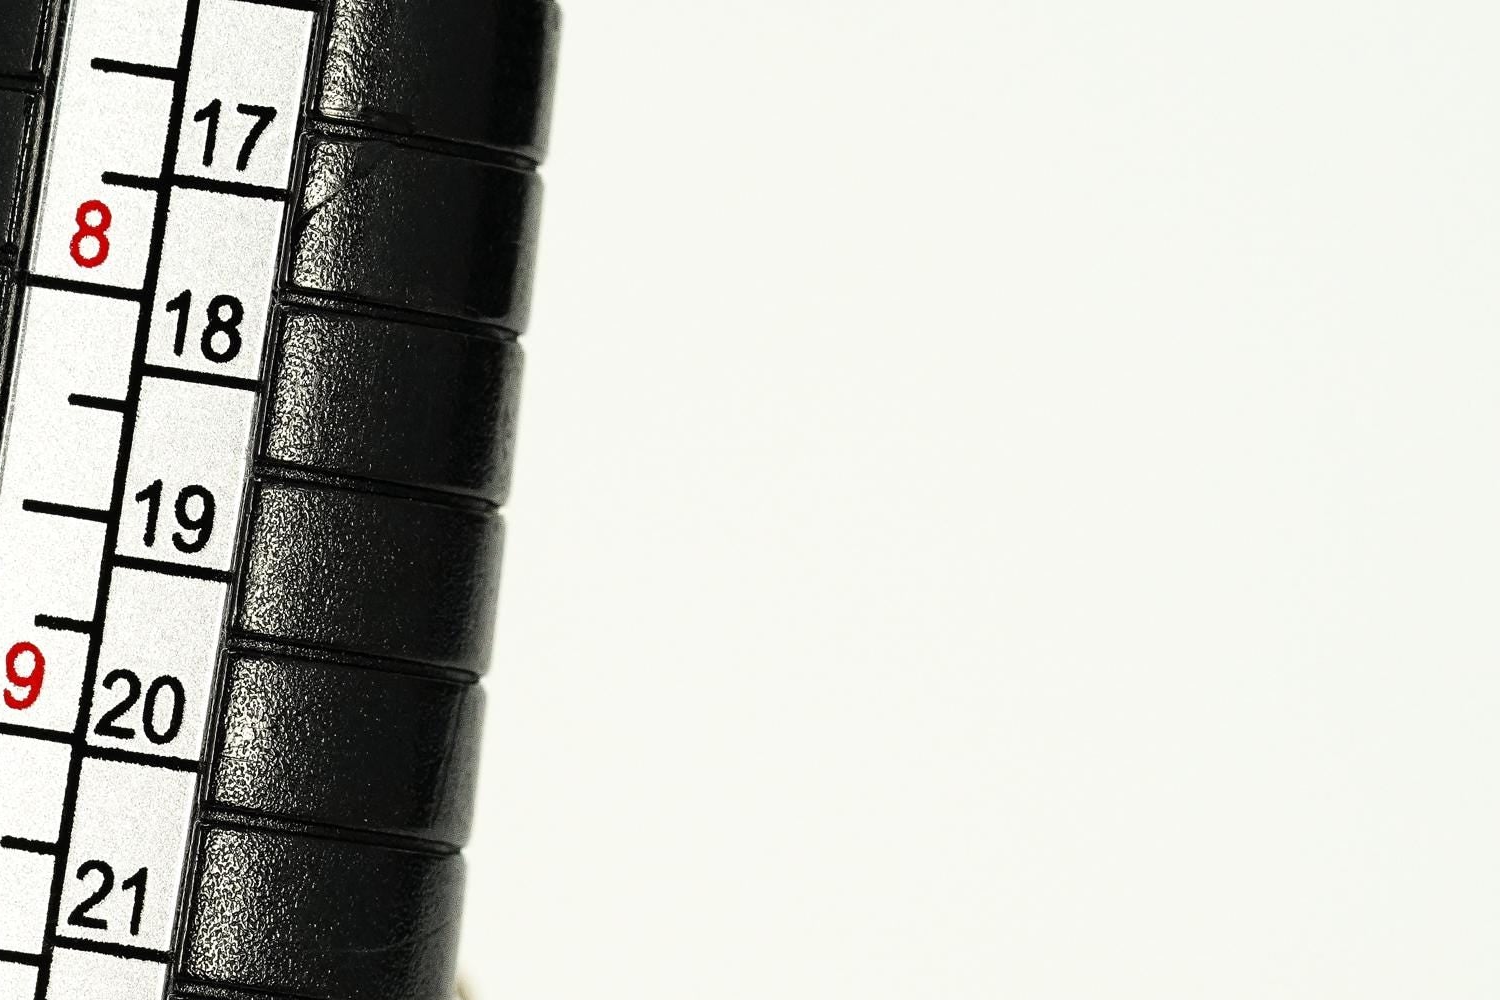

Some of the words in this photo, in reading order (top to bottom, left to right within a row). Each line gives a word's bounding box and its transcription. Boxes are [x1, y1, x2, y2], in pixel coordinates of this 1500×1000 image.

[194, 99, 277, 172] 17
[70, 200, 111, 268] 8
[166, 290, 244, 363] 18
[136, 479, 215, 554] 19
[4, 642, 45, 710] 9
[94, 669, 186, 745] 20
[68, 860, 148, 936] 21
